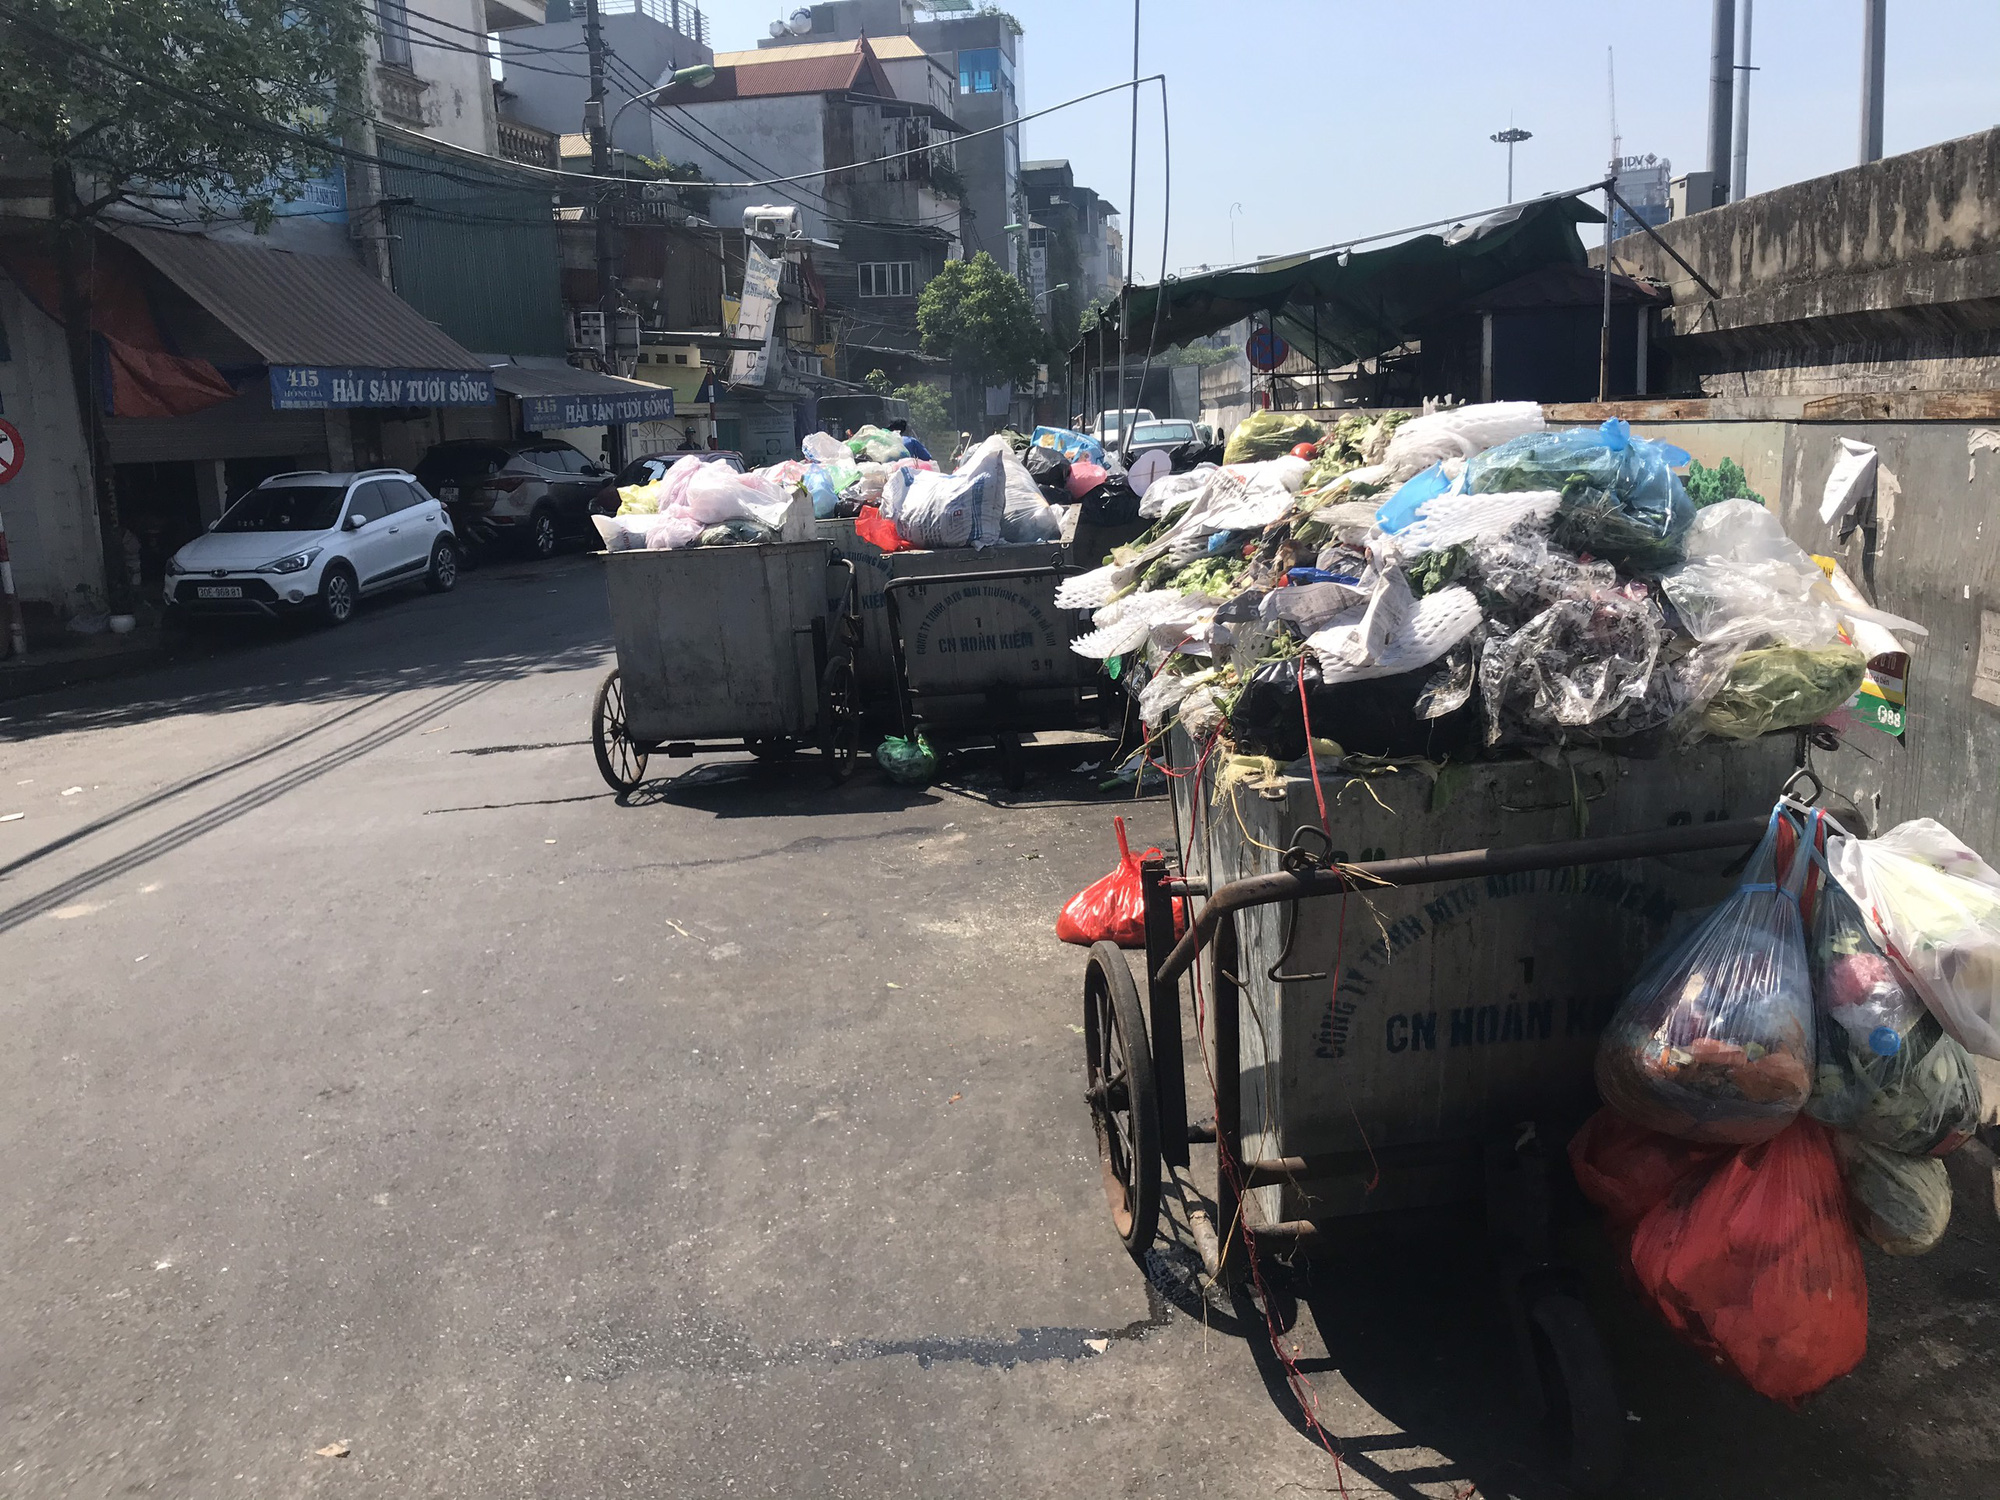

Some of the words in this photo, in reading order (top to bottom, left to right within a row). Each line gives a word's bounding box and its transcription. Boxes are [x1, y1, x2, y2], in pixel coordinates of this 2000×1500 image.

[286, 369, 319, 387] 415
[332, 369, 364, 403] HẢI
[369, 371, 402, 404] SẢN
[406, 376, 447, 403] TƯƠI
[449, 373, 489, 403] SỐNG
[535, 399, 558, 414] 415
[565, 397, 589, 424] HẢI
[644, 393, 671, 417] SỐNG
[975, 617, 982, 628] 1
[938, 637, 957, 653] CN
[960, 632, 997, 652] HOÀN
[1000, 628, 1034, 650] KIẾM
[1877, 704, 1901, 728] F88
[1518, 956, 1535, 984] 1
[1386, 1011, 1437, 1054] CN
[1450, 993, 1552, 1048] HOÀN
